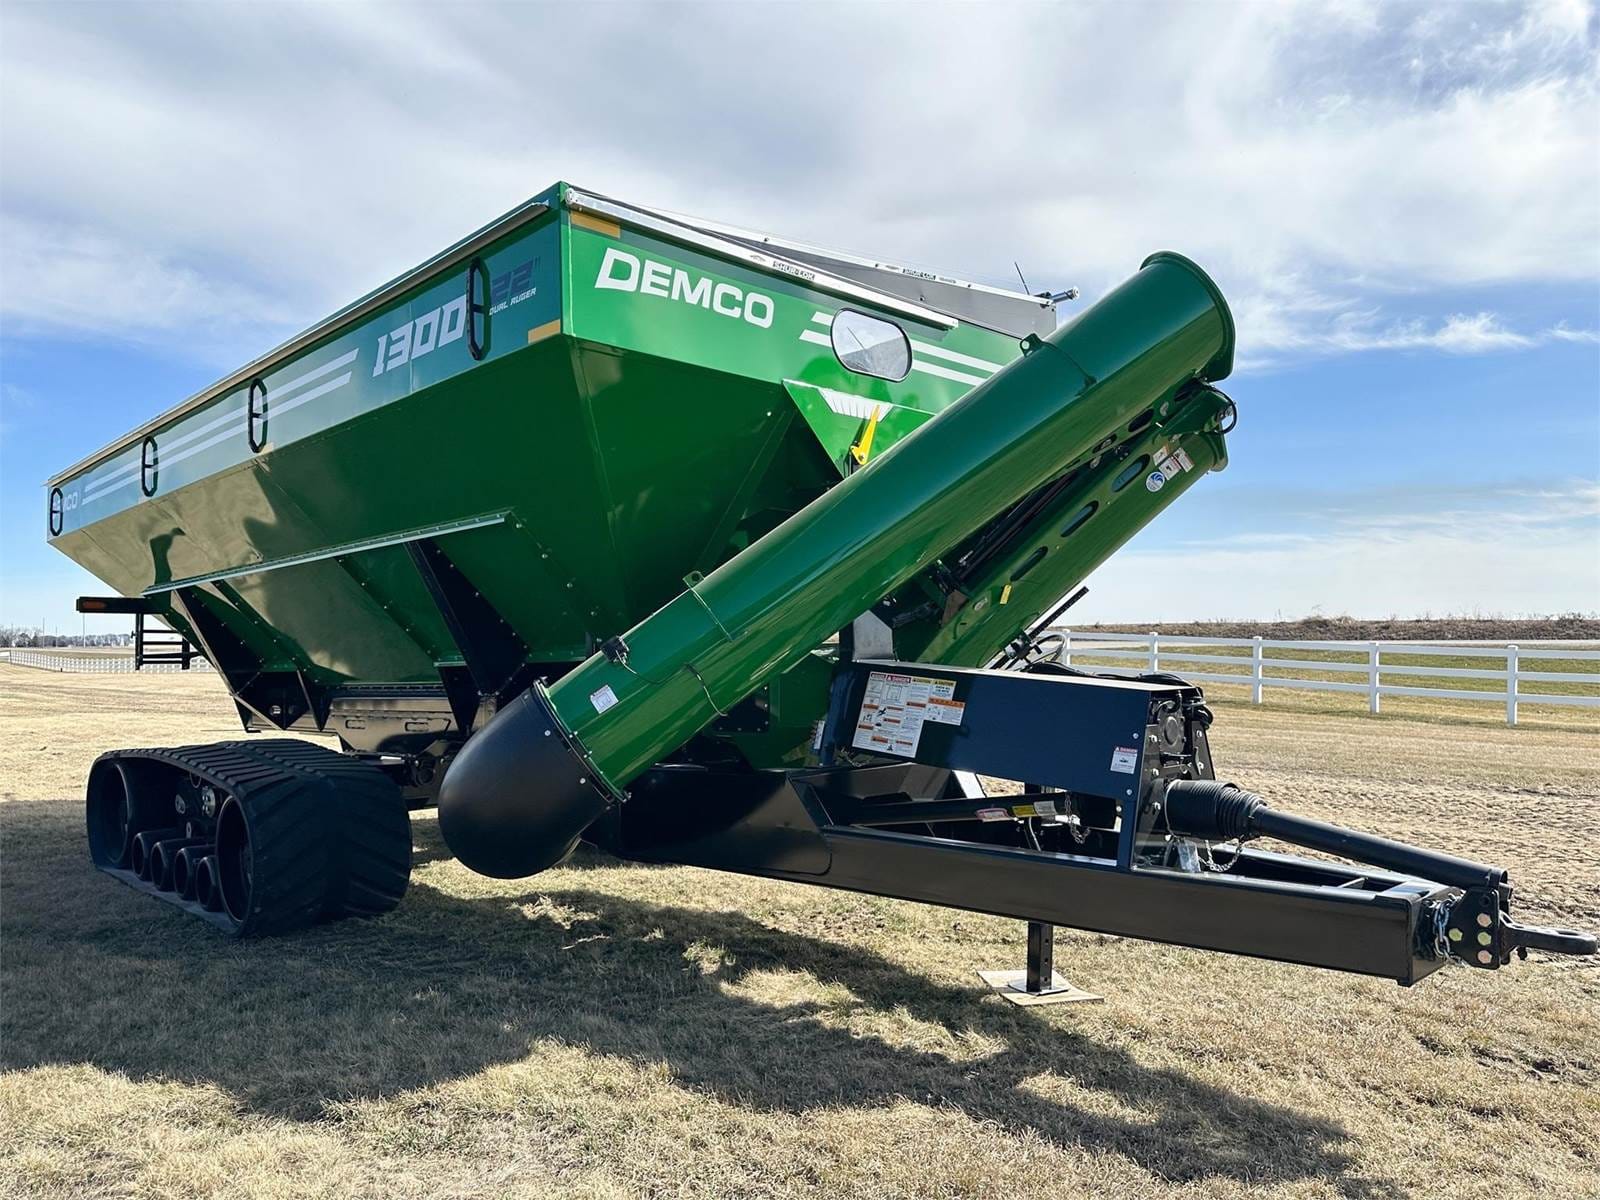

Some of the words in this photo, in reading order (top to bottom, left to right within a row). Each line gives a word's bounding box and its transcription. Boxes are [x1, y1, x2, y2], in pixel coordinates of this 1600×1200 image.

[489, 301, 508, 316] DUAL
[510, 287, 537, 306] AUGER
[595, 247, 775, 329] DEMCO
[372, 294, 468, 377] 1300
